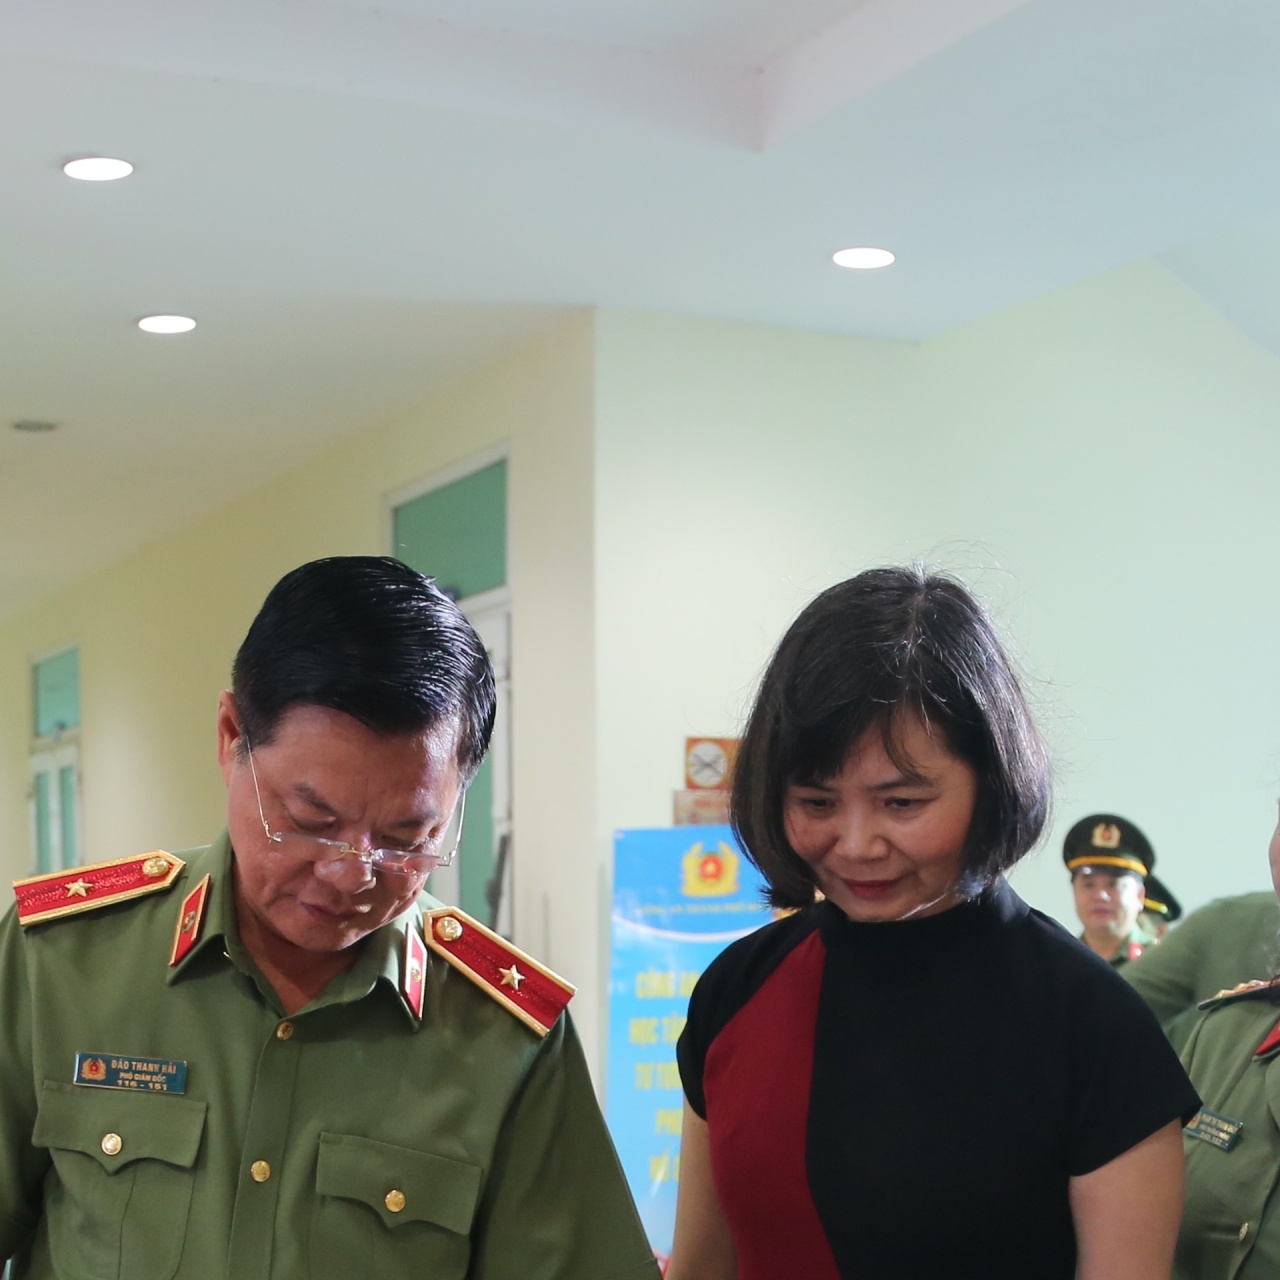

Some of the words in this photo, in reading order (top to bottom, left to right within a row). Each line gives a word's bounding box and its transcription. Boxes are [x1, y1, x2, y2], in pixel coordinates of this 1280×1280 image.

[111, 1058, 129, 1070] ĐÀO
[132, 1061, 159, 1072] THANH
[161, 1062, 176, 1074] HẢI
[119, 1071, 133, 1079] PHÓ
[134, 1072, 151, 1081] GIÁM
